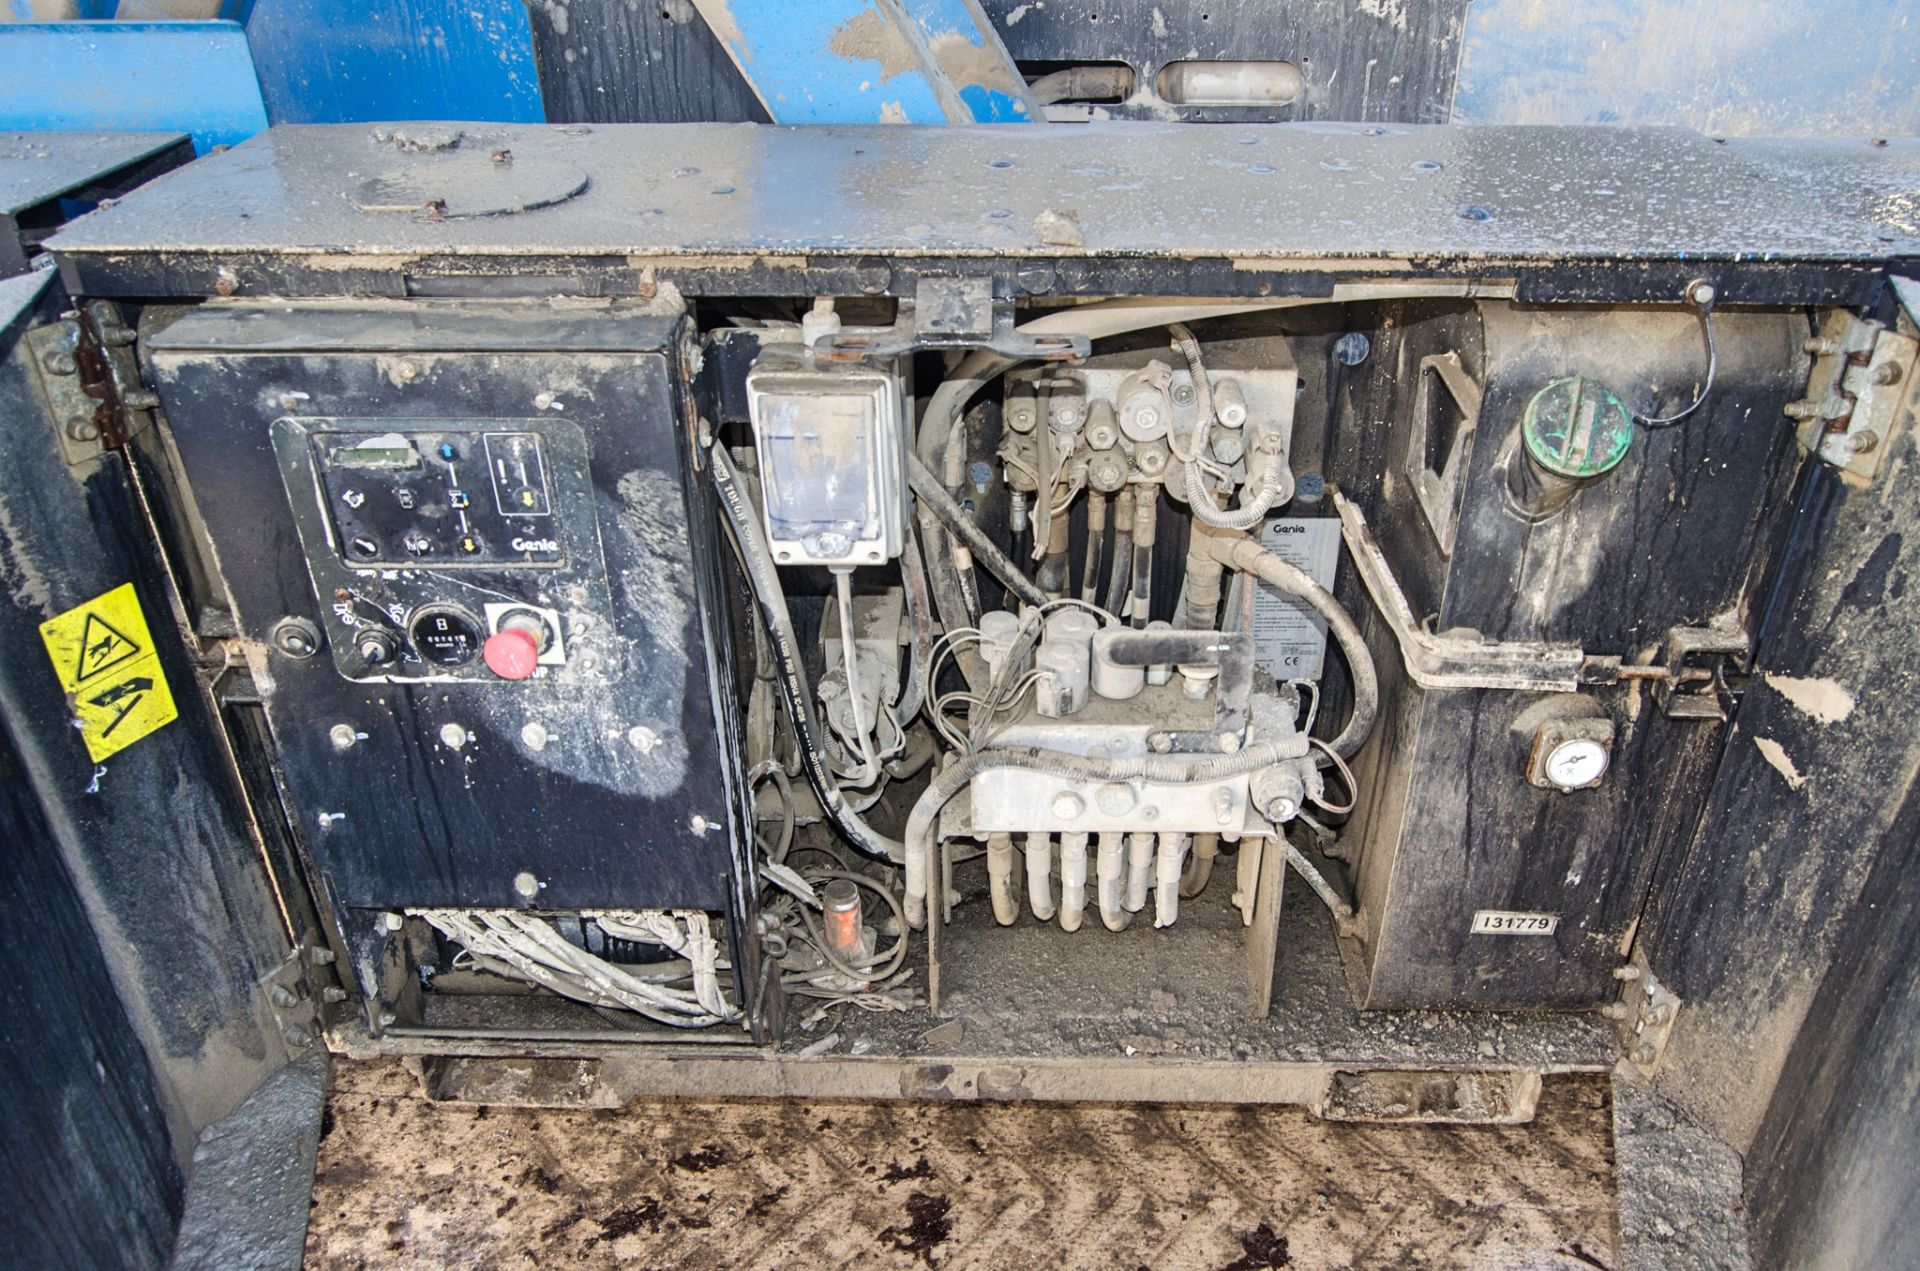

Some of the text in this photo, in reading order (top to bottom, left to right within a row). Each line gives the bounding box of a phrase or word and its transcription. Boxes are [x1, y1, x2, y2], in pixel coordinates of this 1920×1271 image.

[724, 482, 745, 521] TOUGH
[1273, 524, 1305, 534] Genie
[511, 537, 558, 551] Genie
[1284, 656, 1300, 666] CE
